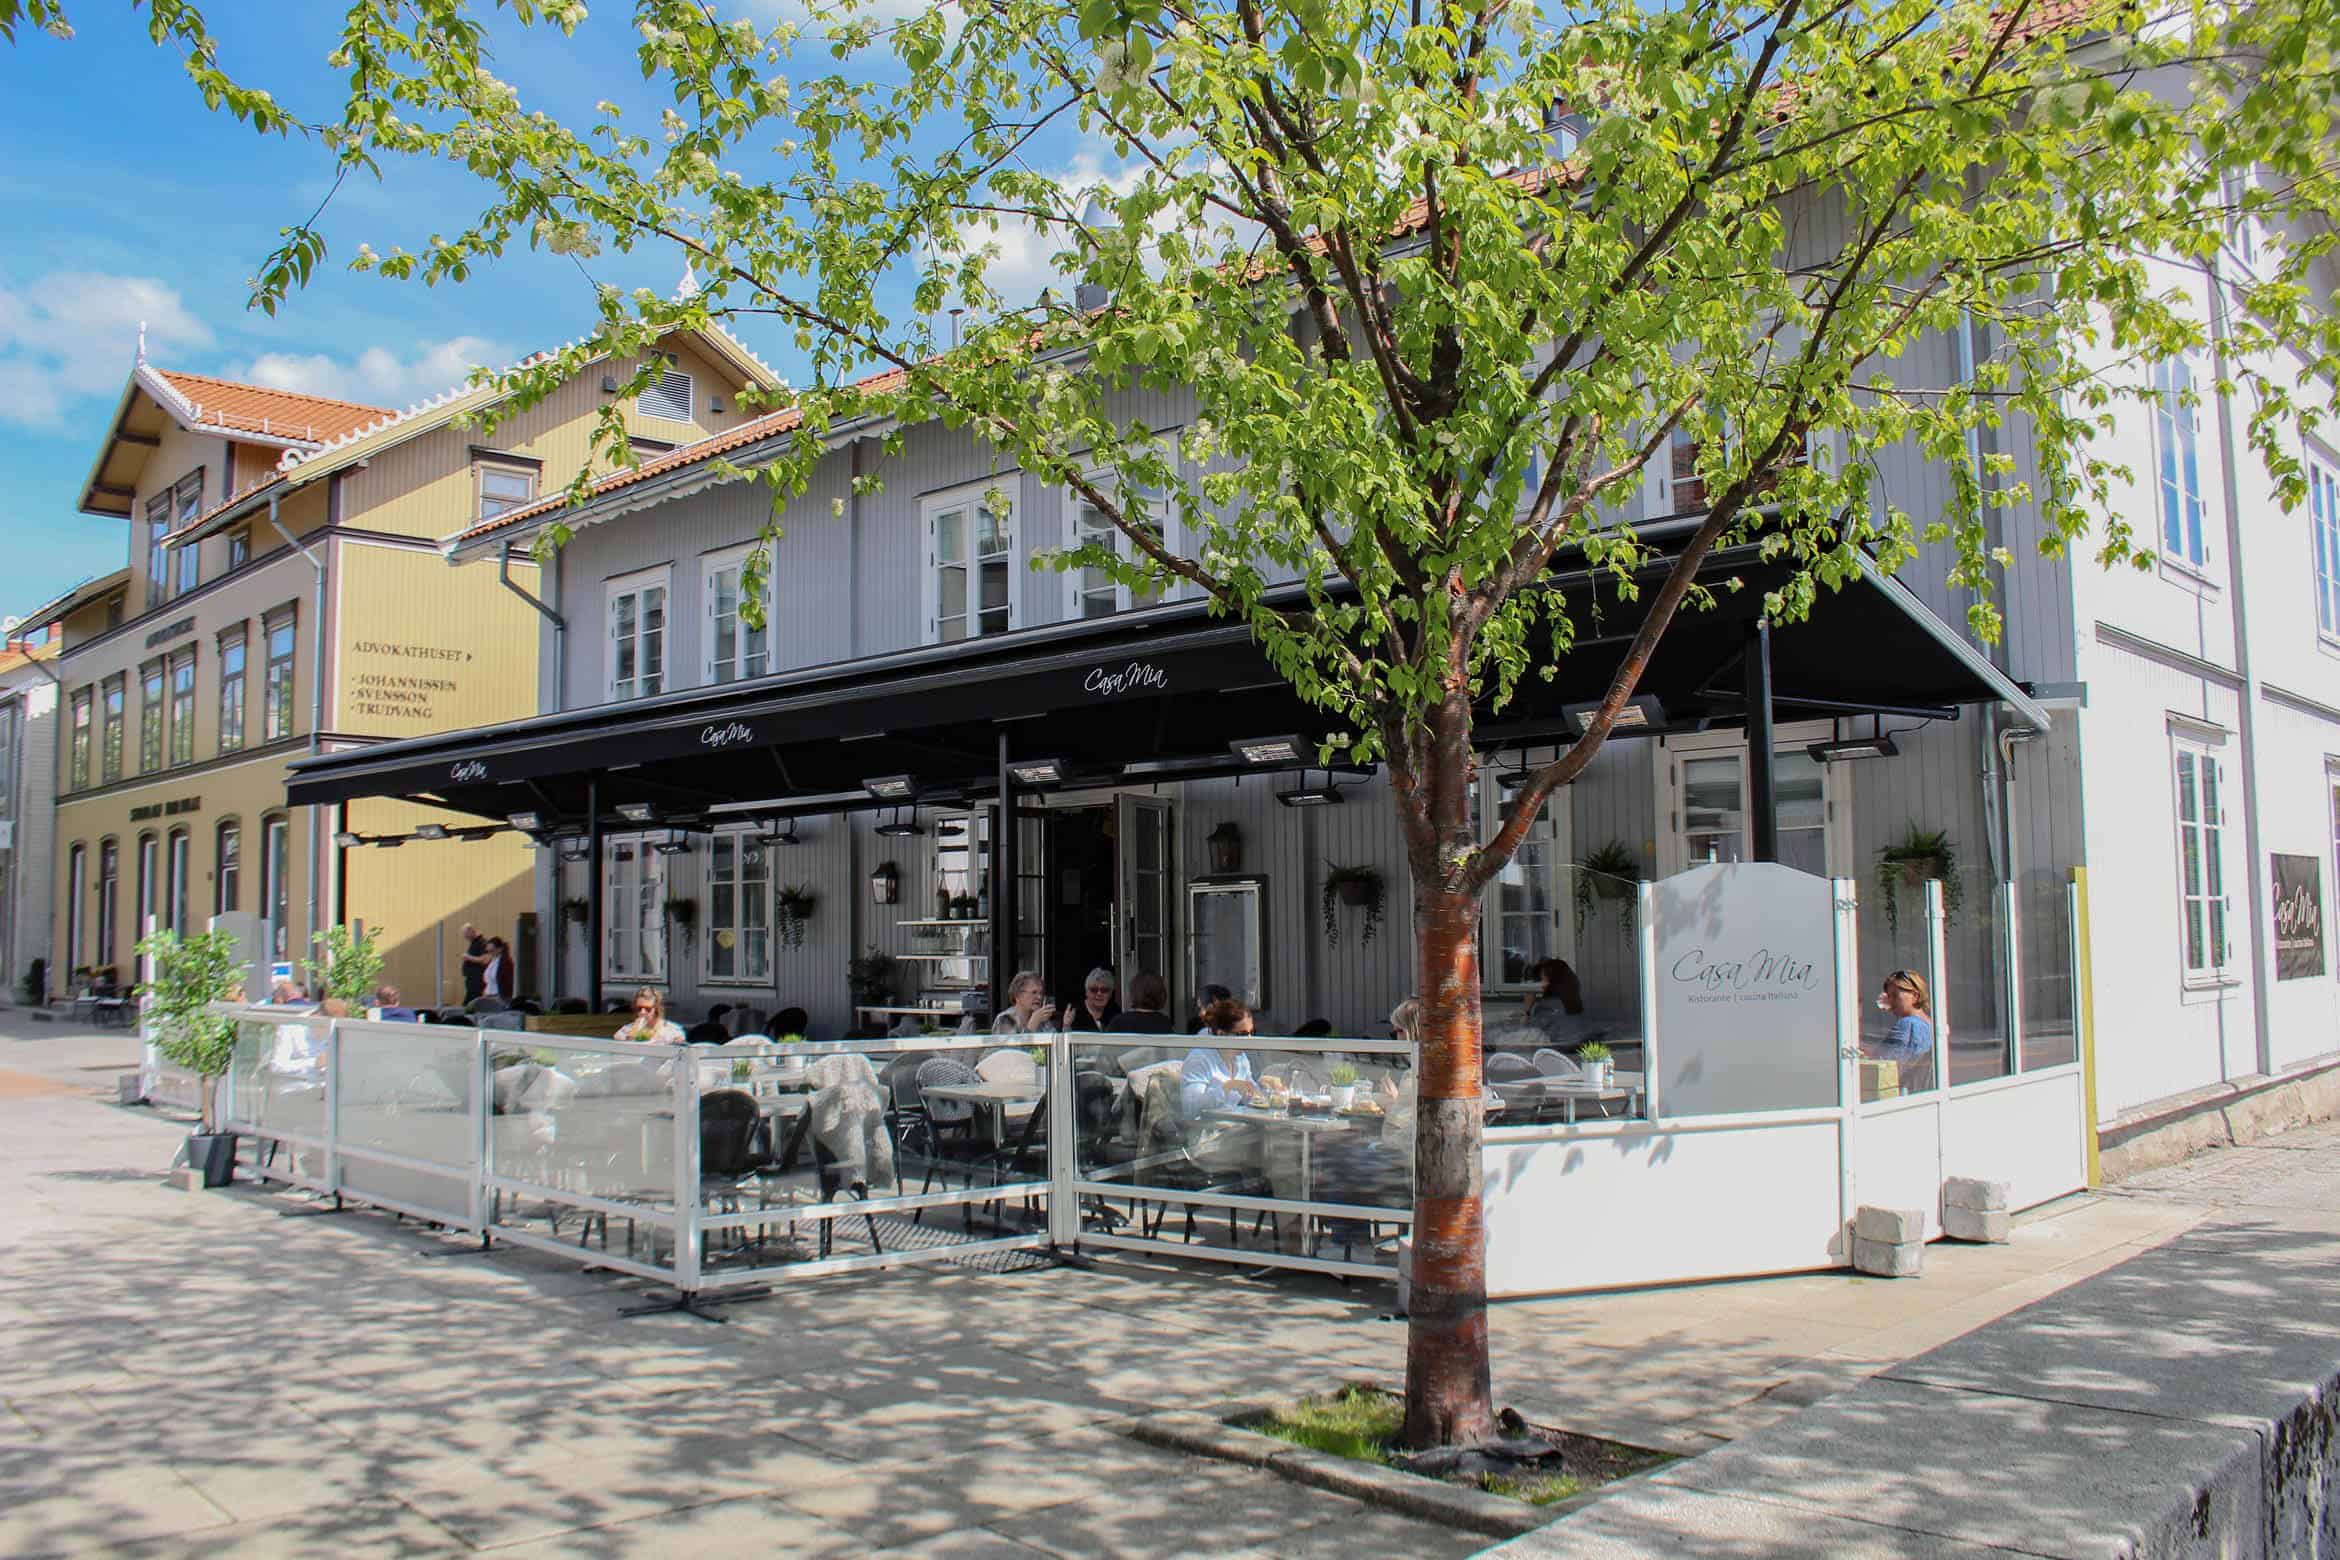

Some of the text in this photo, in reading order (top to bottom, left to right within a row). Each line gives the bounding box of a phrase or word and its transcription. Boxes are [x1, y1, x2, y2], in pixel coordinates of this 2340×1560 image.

[352, 640, 462, 662] ADVOKATHUSET
[359, 673, 457, 691] JOHANNISSEN
[1084, 662, 1168, 695] Casa Mia
[357, 687, 428, 702] SVENSSON
[357, 702, 432, 719] TRUDVANG
[701, 721, 753, 748] Casa Mia
[2295, 885, 2320, 936] Mia
[1672, 949, 1819, 991] Casa Mia
